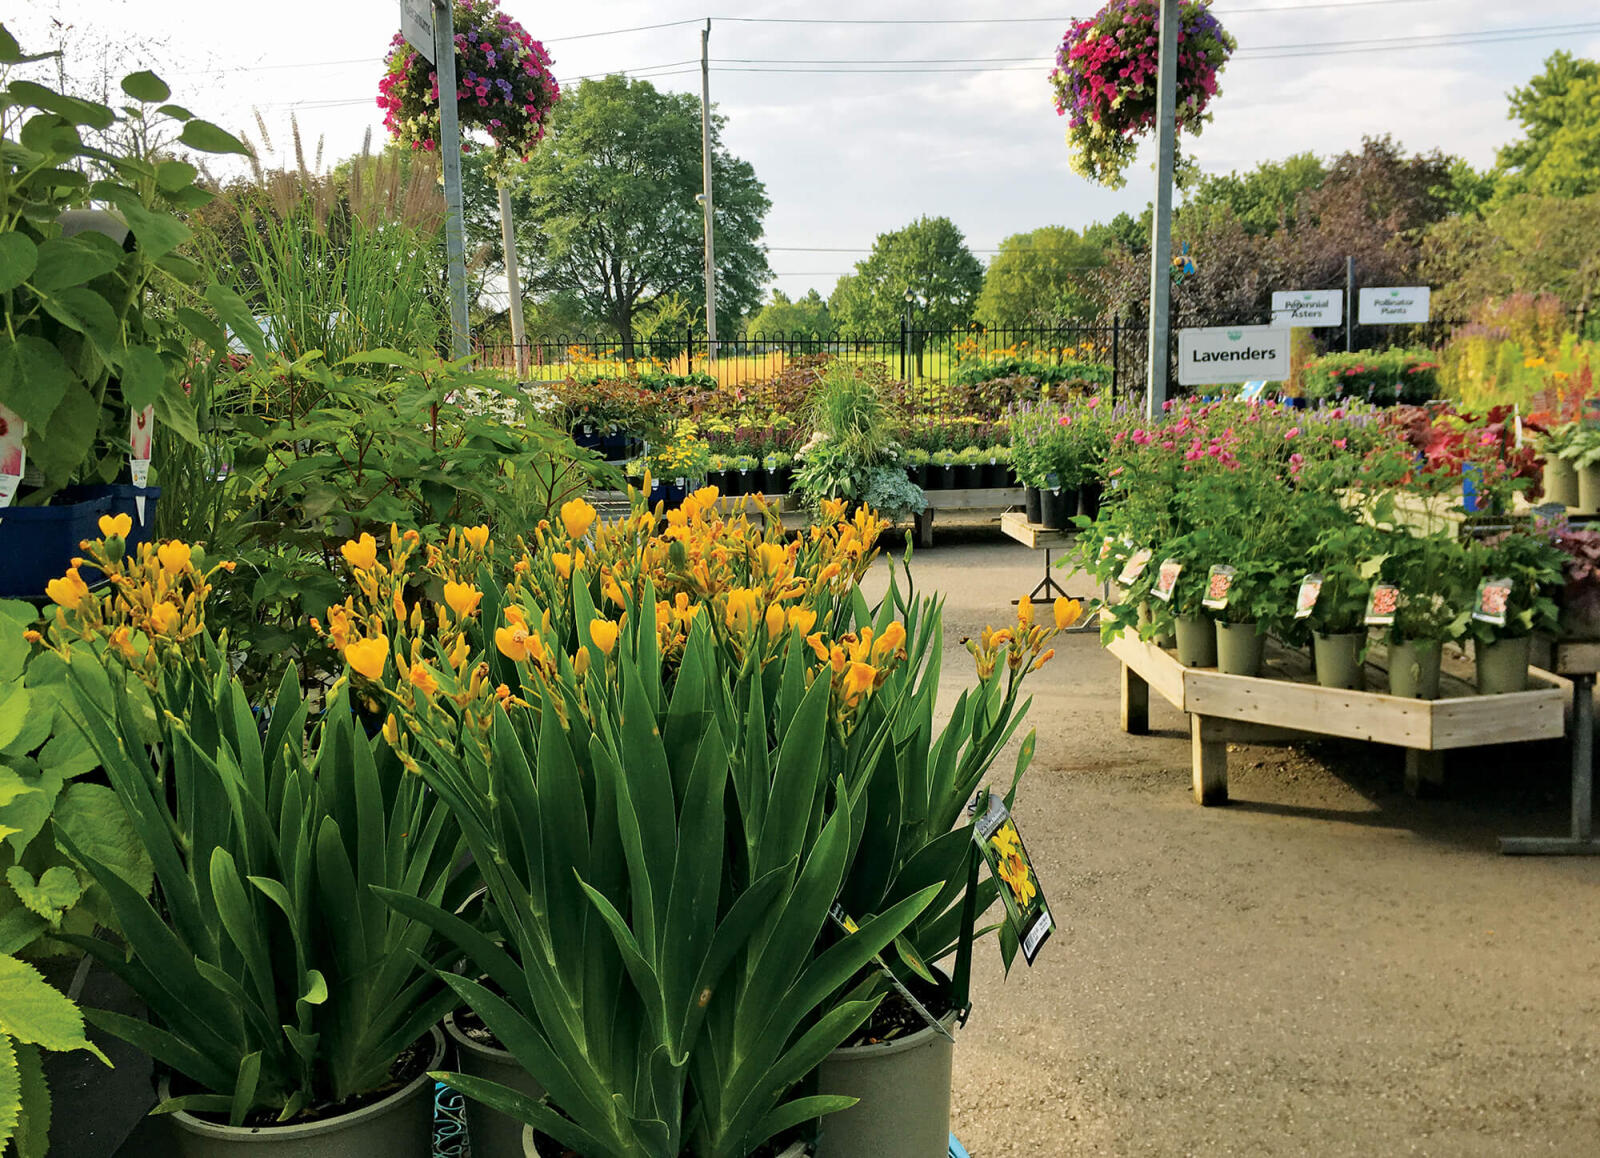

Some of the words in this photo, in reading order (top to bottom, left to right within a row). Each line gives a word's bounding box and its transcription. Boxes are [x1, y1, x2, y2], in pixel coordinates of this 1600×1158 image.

[1374, 299, 1415, 307] Pollinator
[1291, 310, 1322, 318] Asters
[1193, 346, 1276, 362] Lavenders
